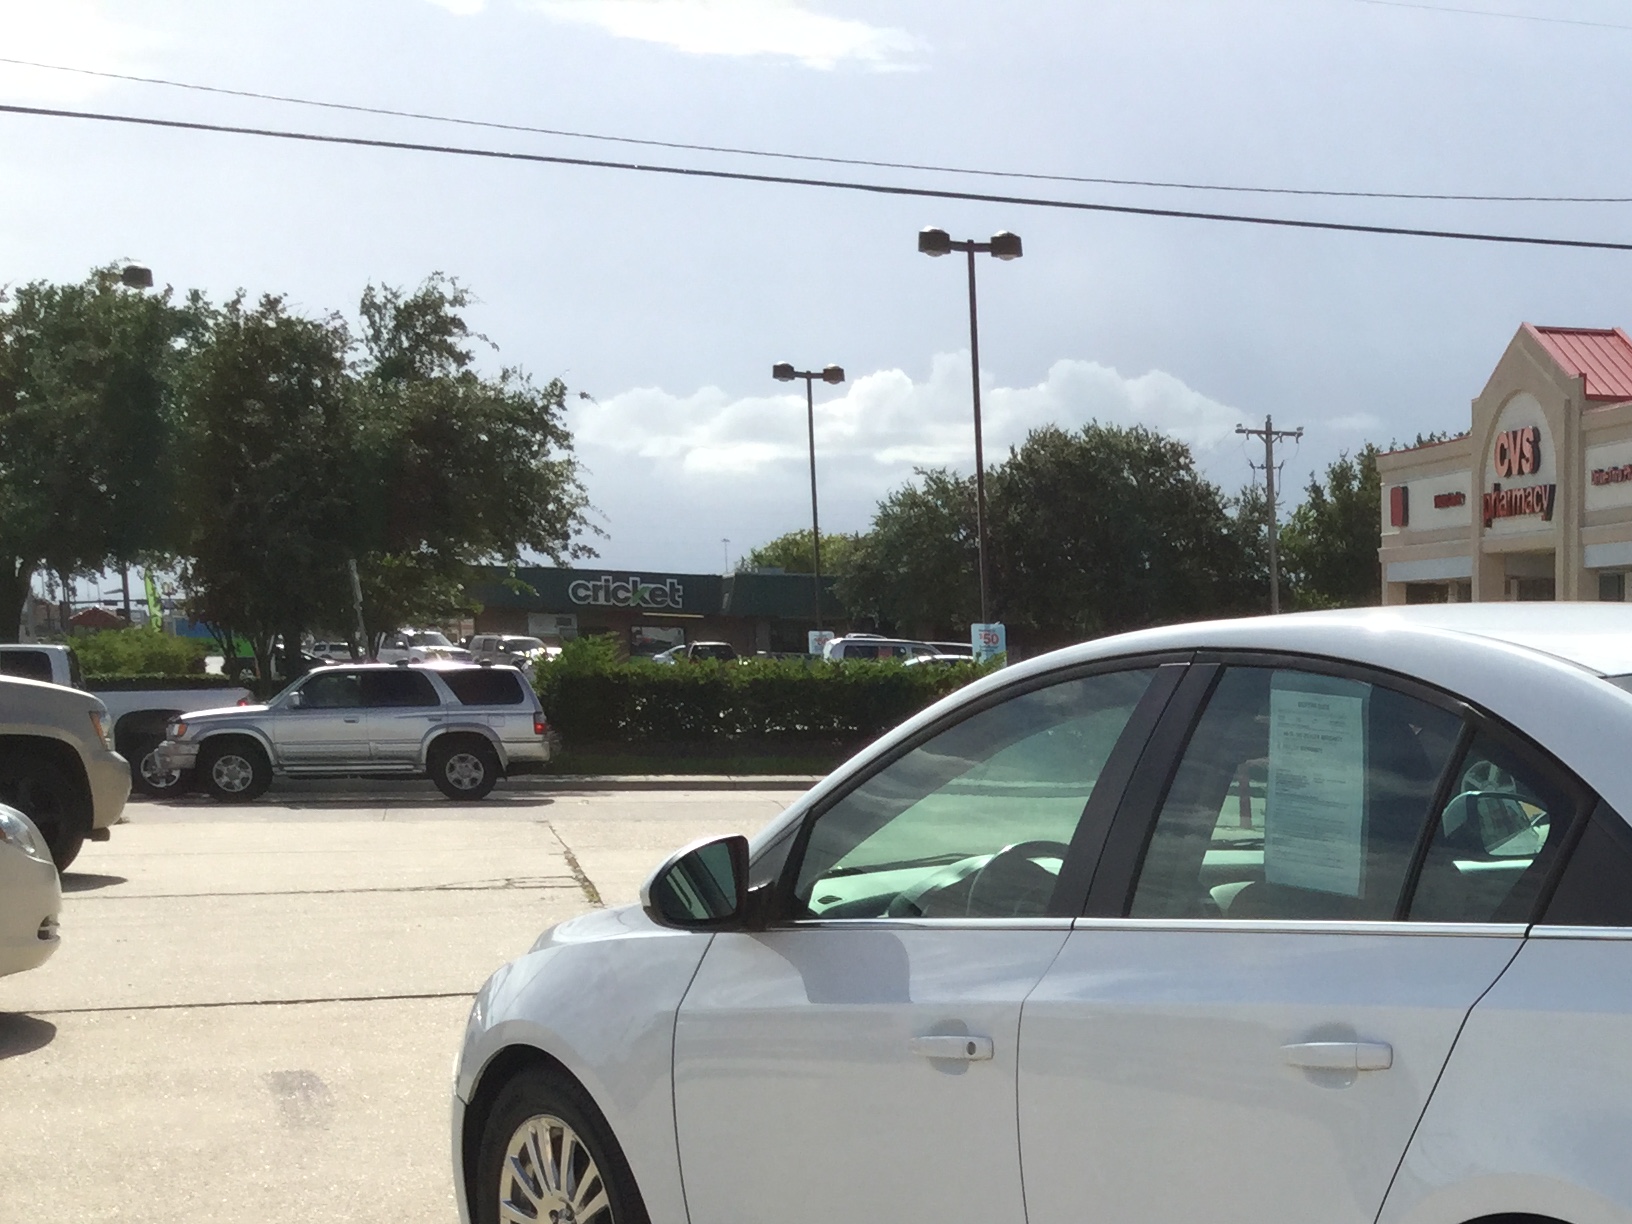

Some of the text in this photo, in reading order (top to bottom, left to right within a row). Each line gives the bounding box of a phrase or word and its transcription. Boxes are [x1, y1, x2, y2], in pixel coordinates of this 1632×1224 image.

[1494, 426, 1541, 478] CVS
[1482, 482, 1557, 528] pharmacy
[568, 575, 683, 609] cricket
